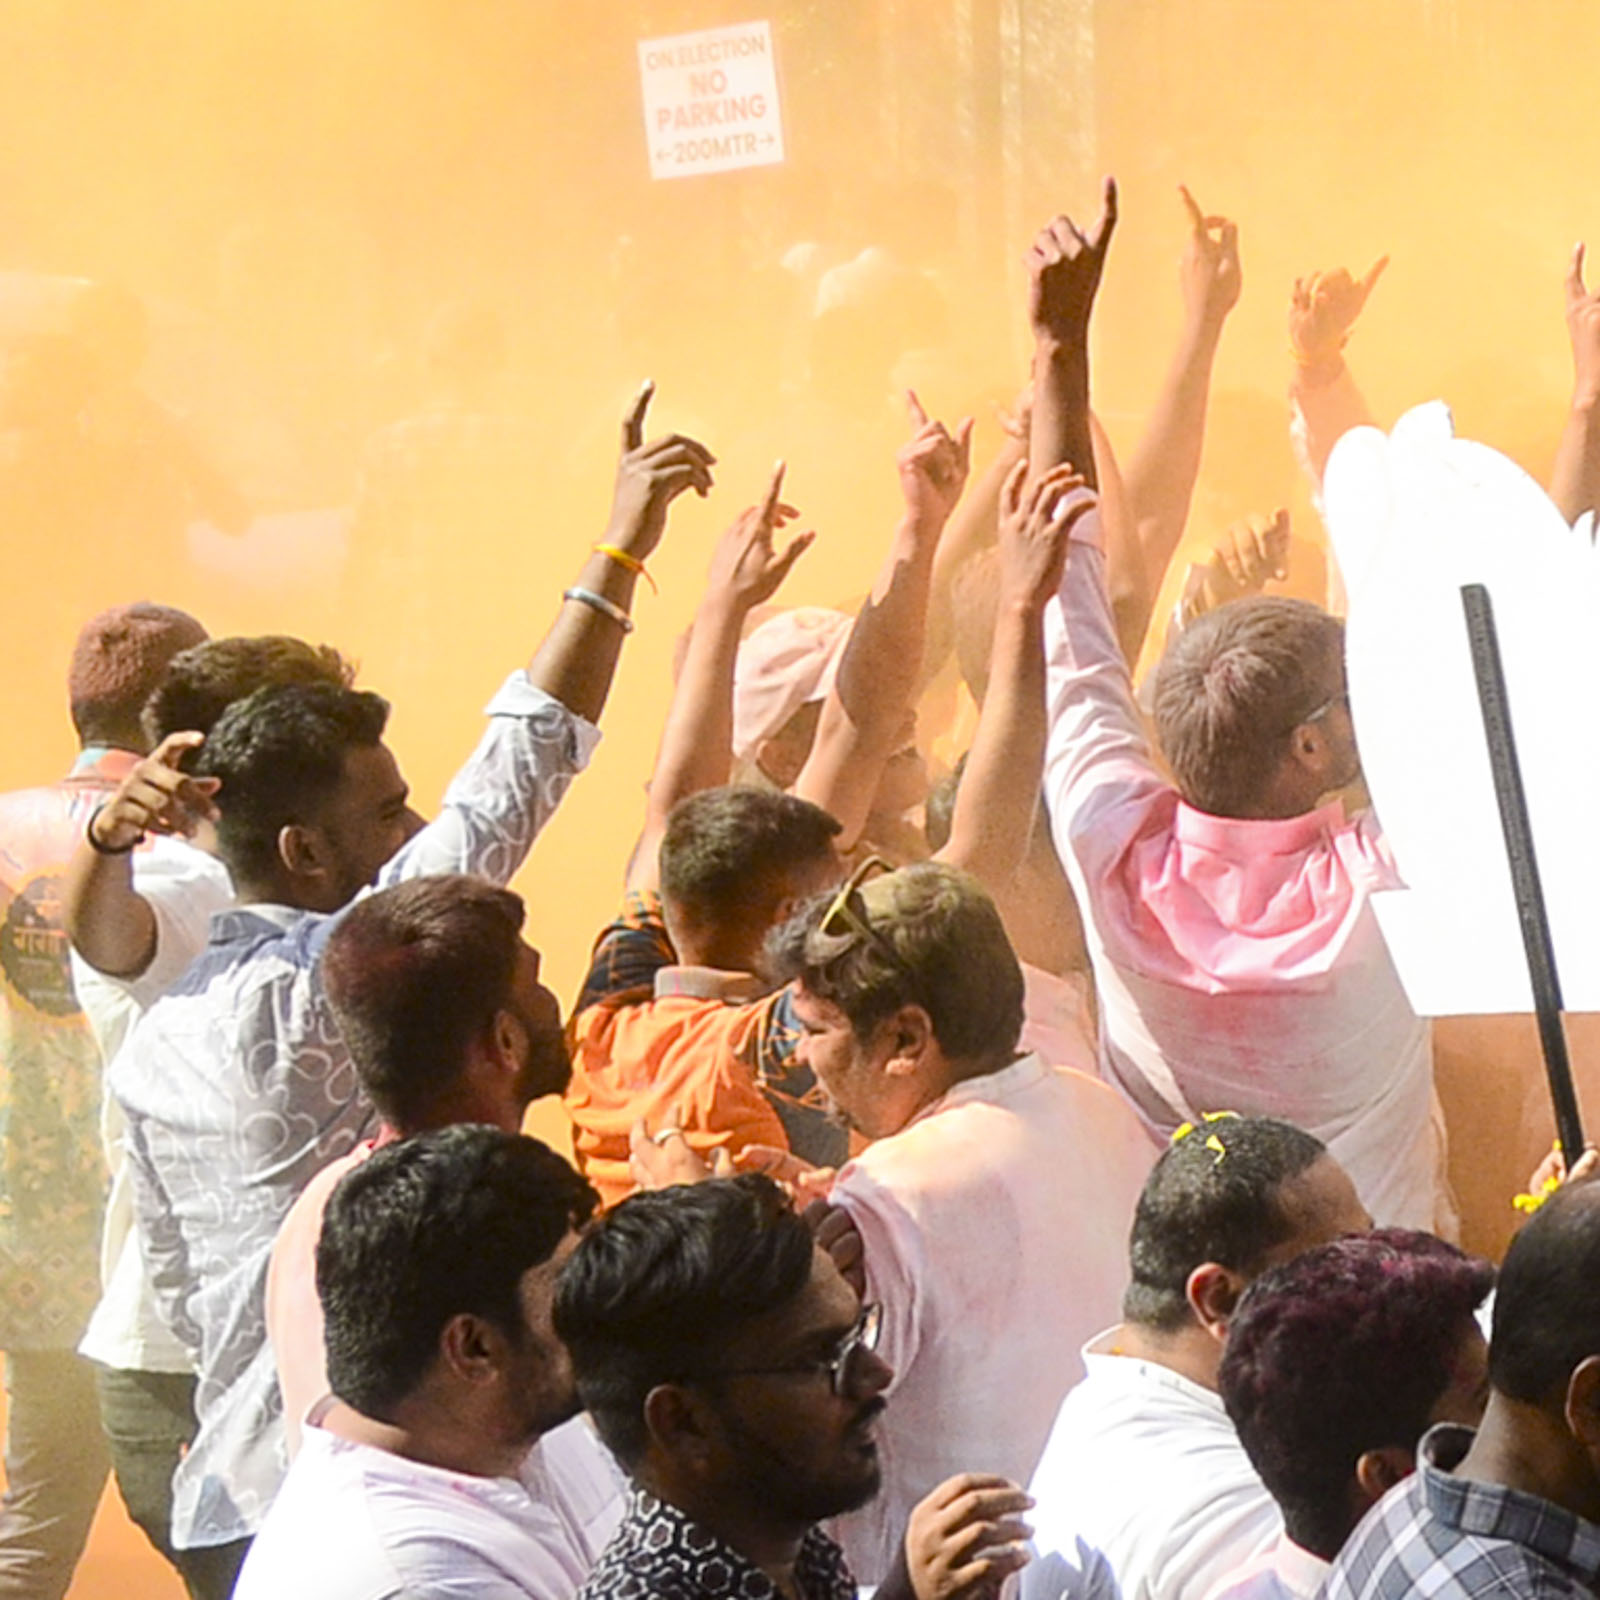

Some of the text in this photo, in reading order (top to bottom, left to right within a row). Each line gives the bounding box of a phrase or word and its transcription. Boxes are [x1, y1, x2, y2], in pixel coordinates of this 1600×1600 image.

[679, 34, 766, 66] ELECTION
[688, 69, 729, 97] NO
[656, 93, 767, 132] PARKING
